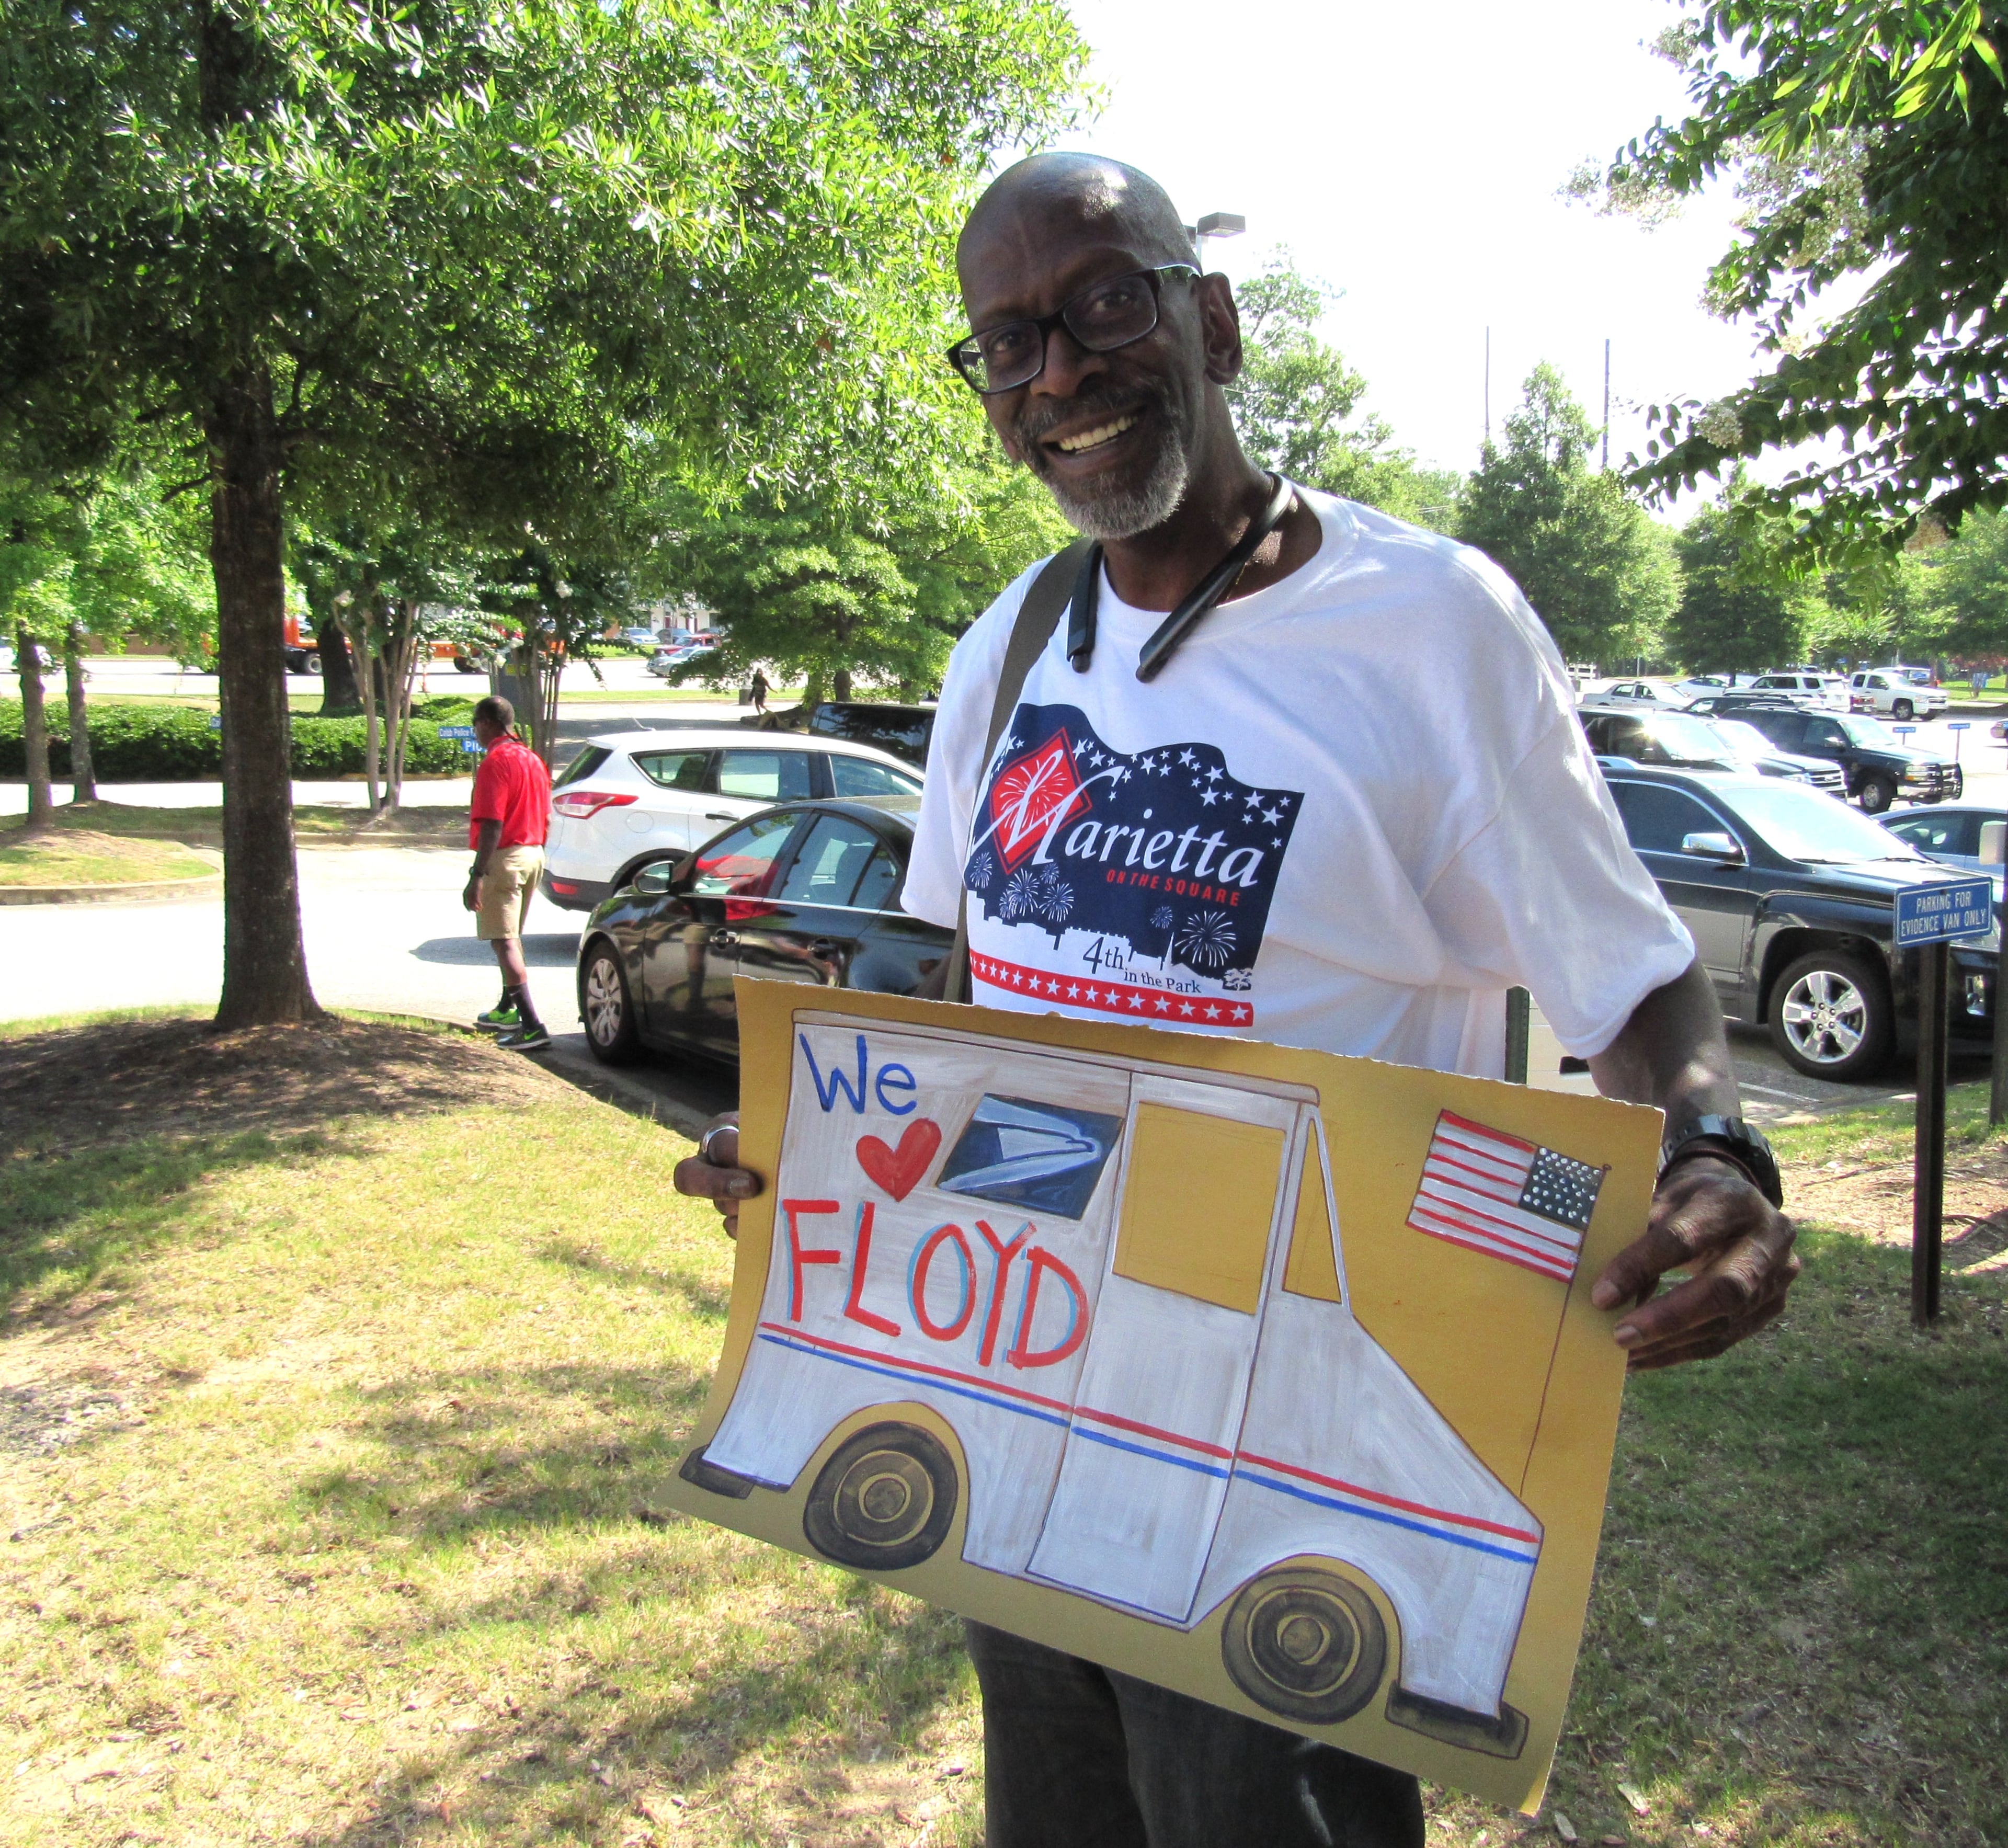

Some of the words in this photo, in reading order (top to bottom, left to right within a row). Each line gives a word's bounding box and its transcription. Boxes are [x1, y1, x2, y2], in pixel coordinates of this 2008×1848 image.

[971, 749, 1264, 888] Marietta
[1106, 869, 1126, 884] ON
[1130, 872, 1159, 889] THE
[1165, 877, 1240, 907] SQUARE
[1916, 893, 1951, 914] PARKING
[1955, 891, 1972, 908] FOR
[1901, 915, 1939, 937] EVIDENCE
[1943, 912, 1960, 930] VAN
[1964, 908, 1987, 927] ONLY
[1082, 936, 1123, 975] 4th
[1124, 968, 1137, 984] in
[1140, 972, 1162, 987] the
[1166, 977, 1202, 994] Park
[798, 1032, 917, 1116] We
[779, 1199, 1090, 1370] FLOYD
